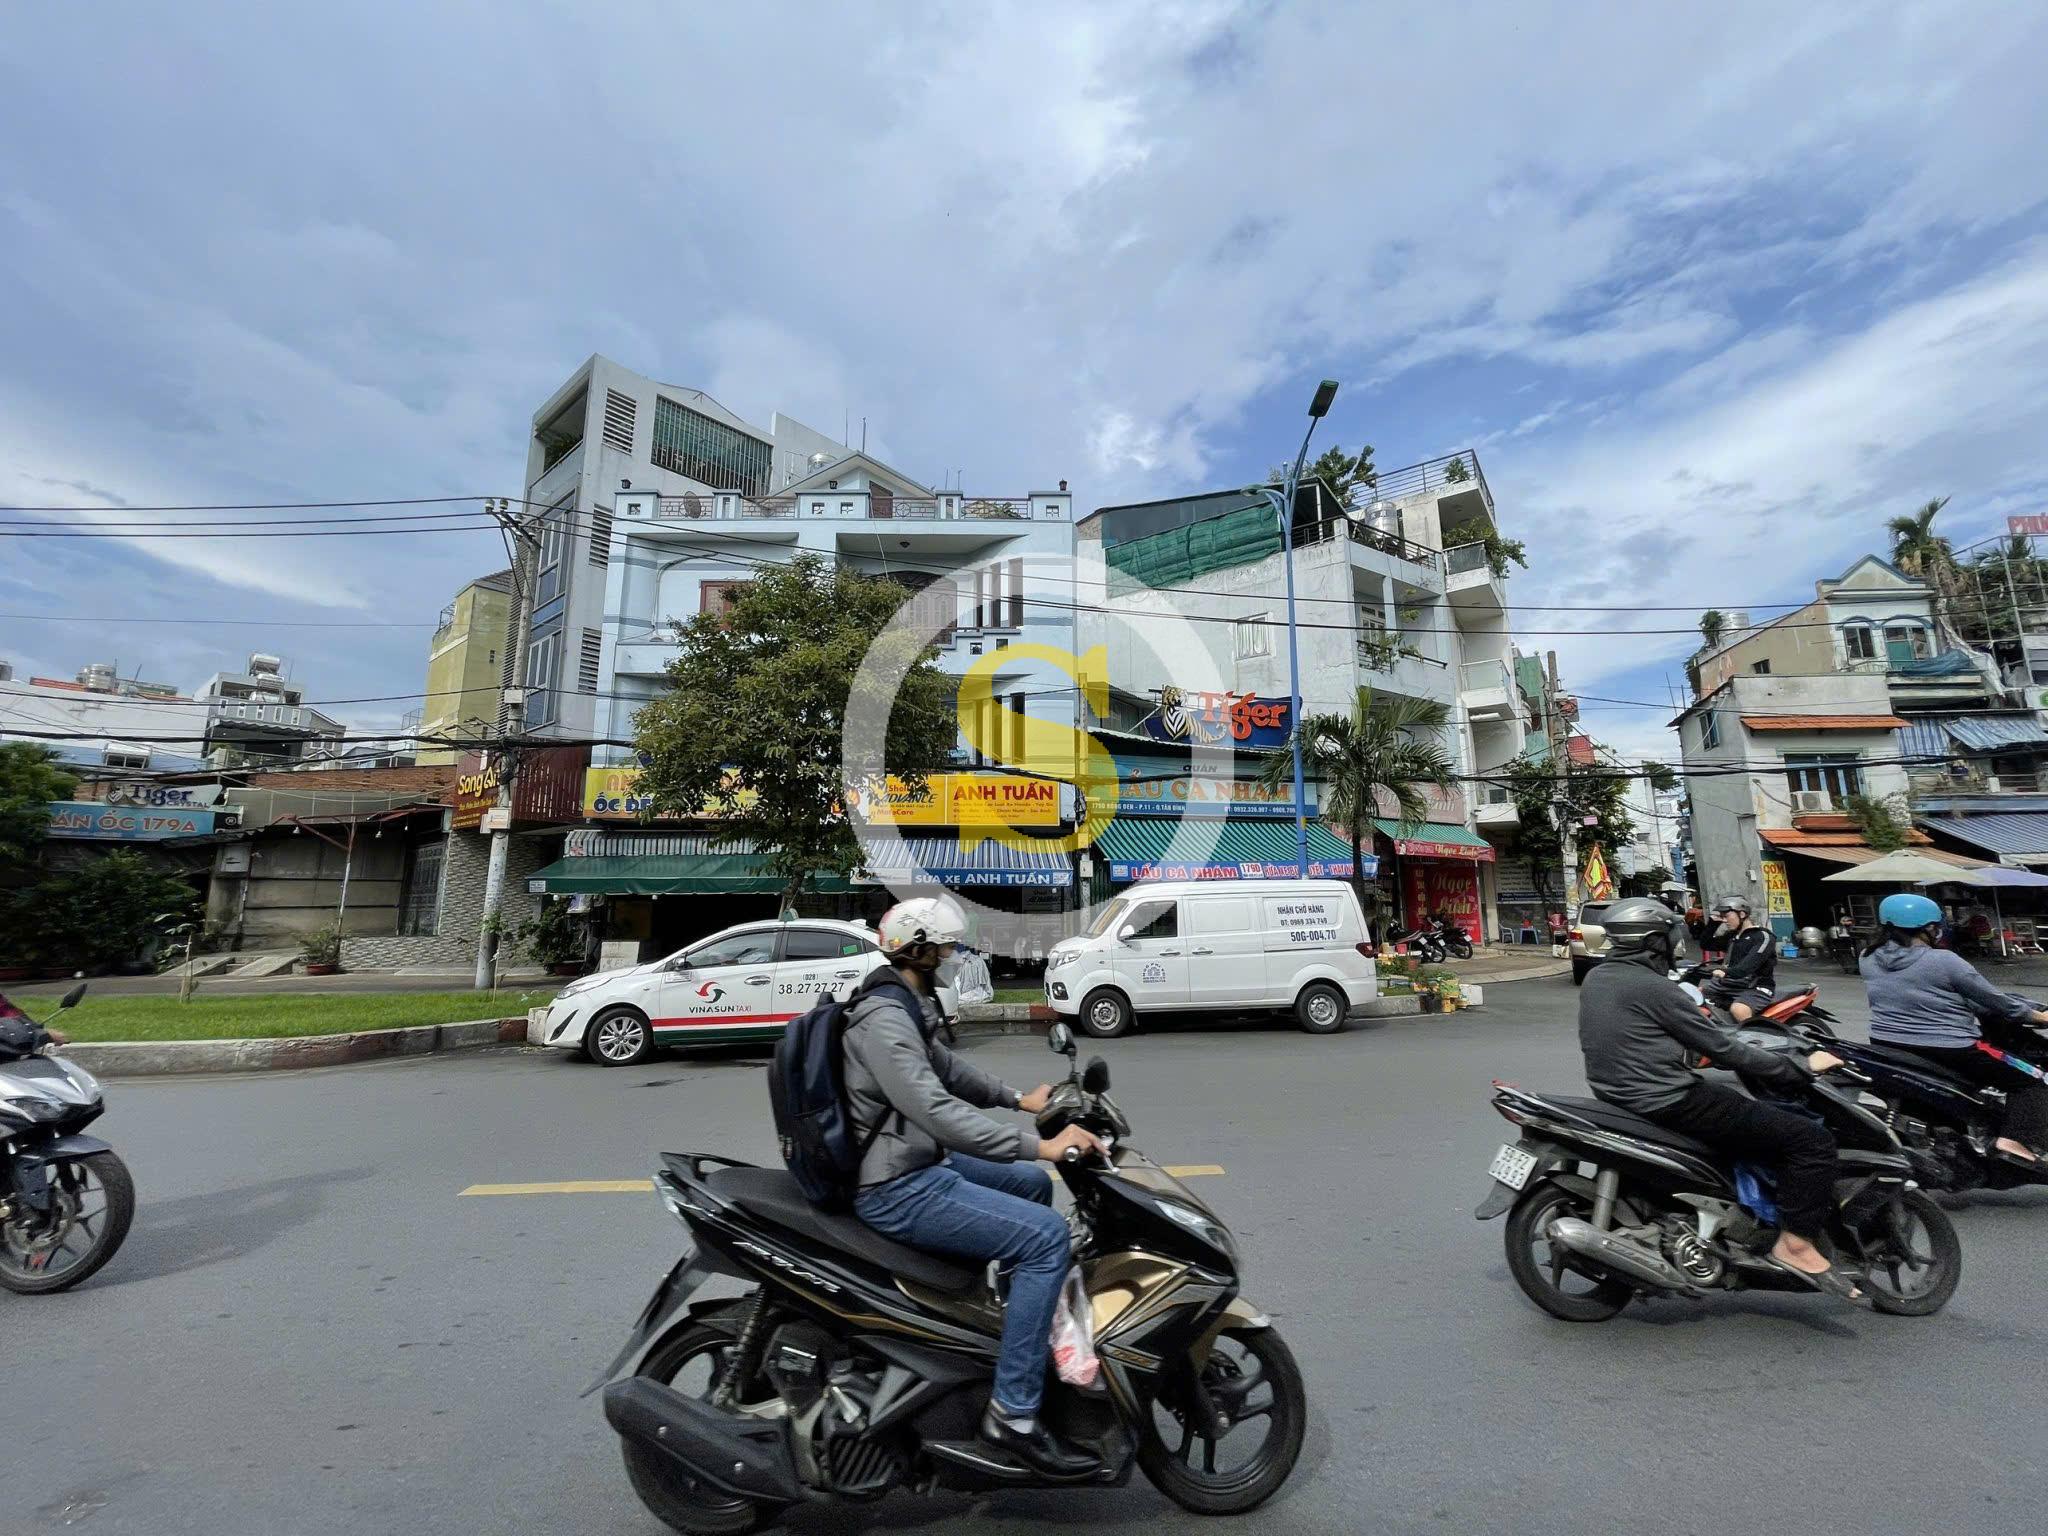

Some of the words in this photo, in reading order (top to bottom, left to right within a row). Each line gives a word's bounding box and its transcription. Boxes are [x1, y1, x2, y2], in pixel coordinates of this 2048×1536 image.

[1199, 690, 1288, 740] Tiger
[130, 784, 193, 806] Tiger
[457, 775, 483, 797] Song
[953, 785, 997, 801] ANH
[1002, 781, 1054, 801] TUẤN
[166, 801, 210, 809] CRYSTAL
[593, 791, 620, 813] ỐC
[99, 810, 136, 831] ỐC
[144, 817, 198, 832] 179A
[945, 875, 960, 884] XE
[966, 873, 1000, 885] ANH
[1007, 871, 1050, 885] TUẤN
[1165, 865, 1188, 879] CÁ
[1191, 865, 1238, 879] NHÁM
[1290, 929, 1337, 942] 50G-004.70
[689, 1005, 735, 1014] VINASUN
